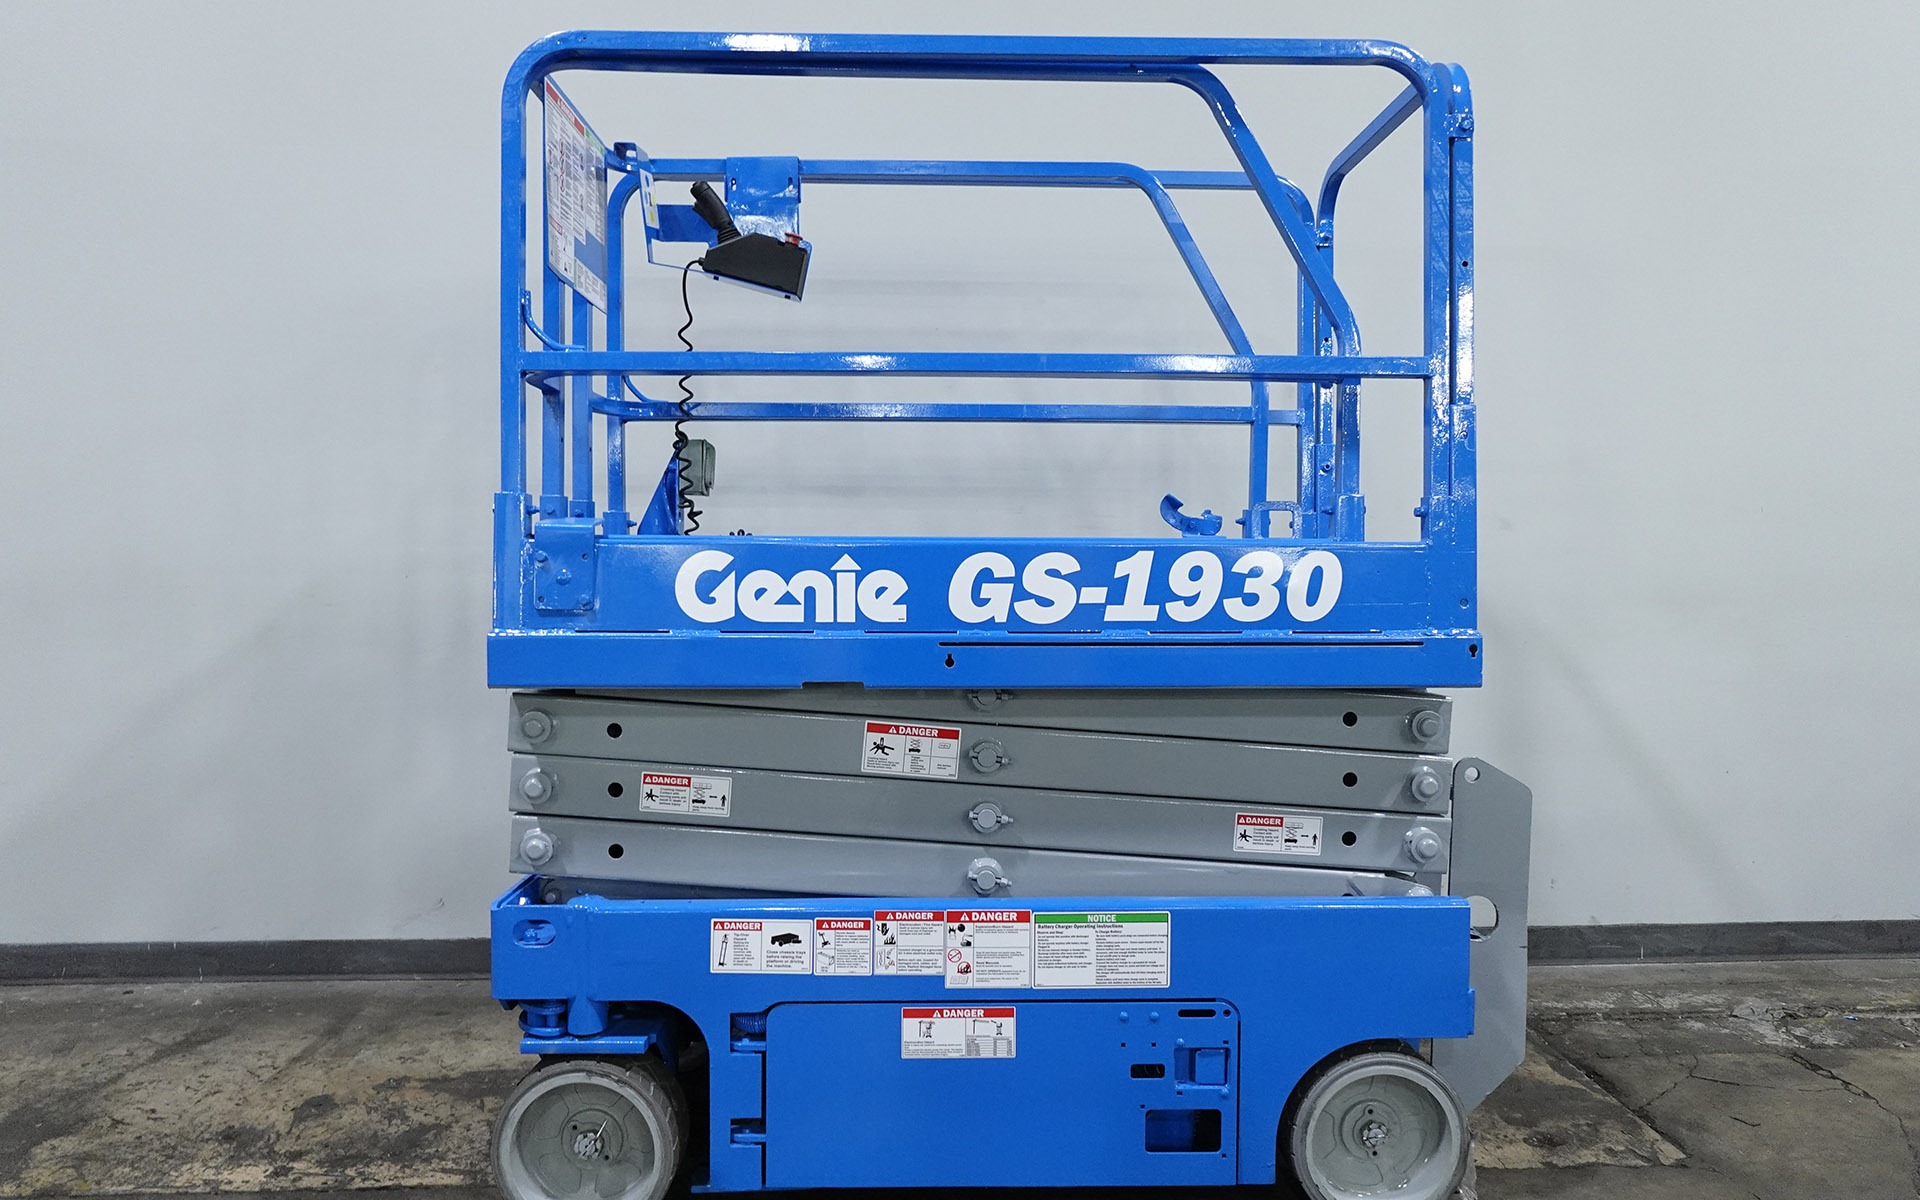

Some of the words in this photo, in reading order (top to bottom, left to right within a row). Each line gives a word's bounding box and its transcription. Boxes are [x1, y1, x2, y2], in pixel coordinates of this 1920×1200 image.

[675, 550, 908, 623] Genie
[949, 547, 1342, 625] GS-1930
[898, 726, 939, 737] DANGER
[652, 776, 689, 785] DANGER
[1246, 817, 1281, 825] DANGER
[896, 912, 934, 920] DANGER
[972, 912, 1018, 921] DANGER
[1087, 914, 1117, 922] NOTICE
[724, 922, 761, 930] DANGER
[831, 921, 864, 929] DANGER
[943, 1009, 984, 1018] DANGER
